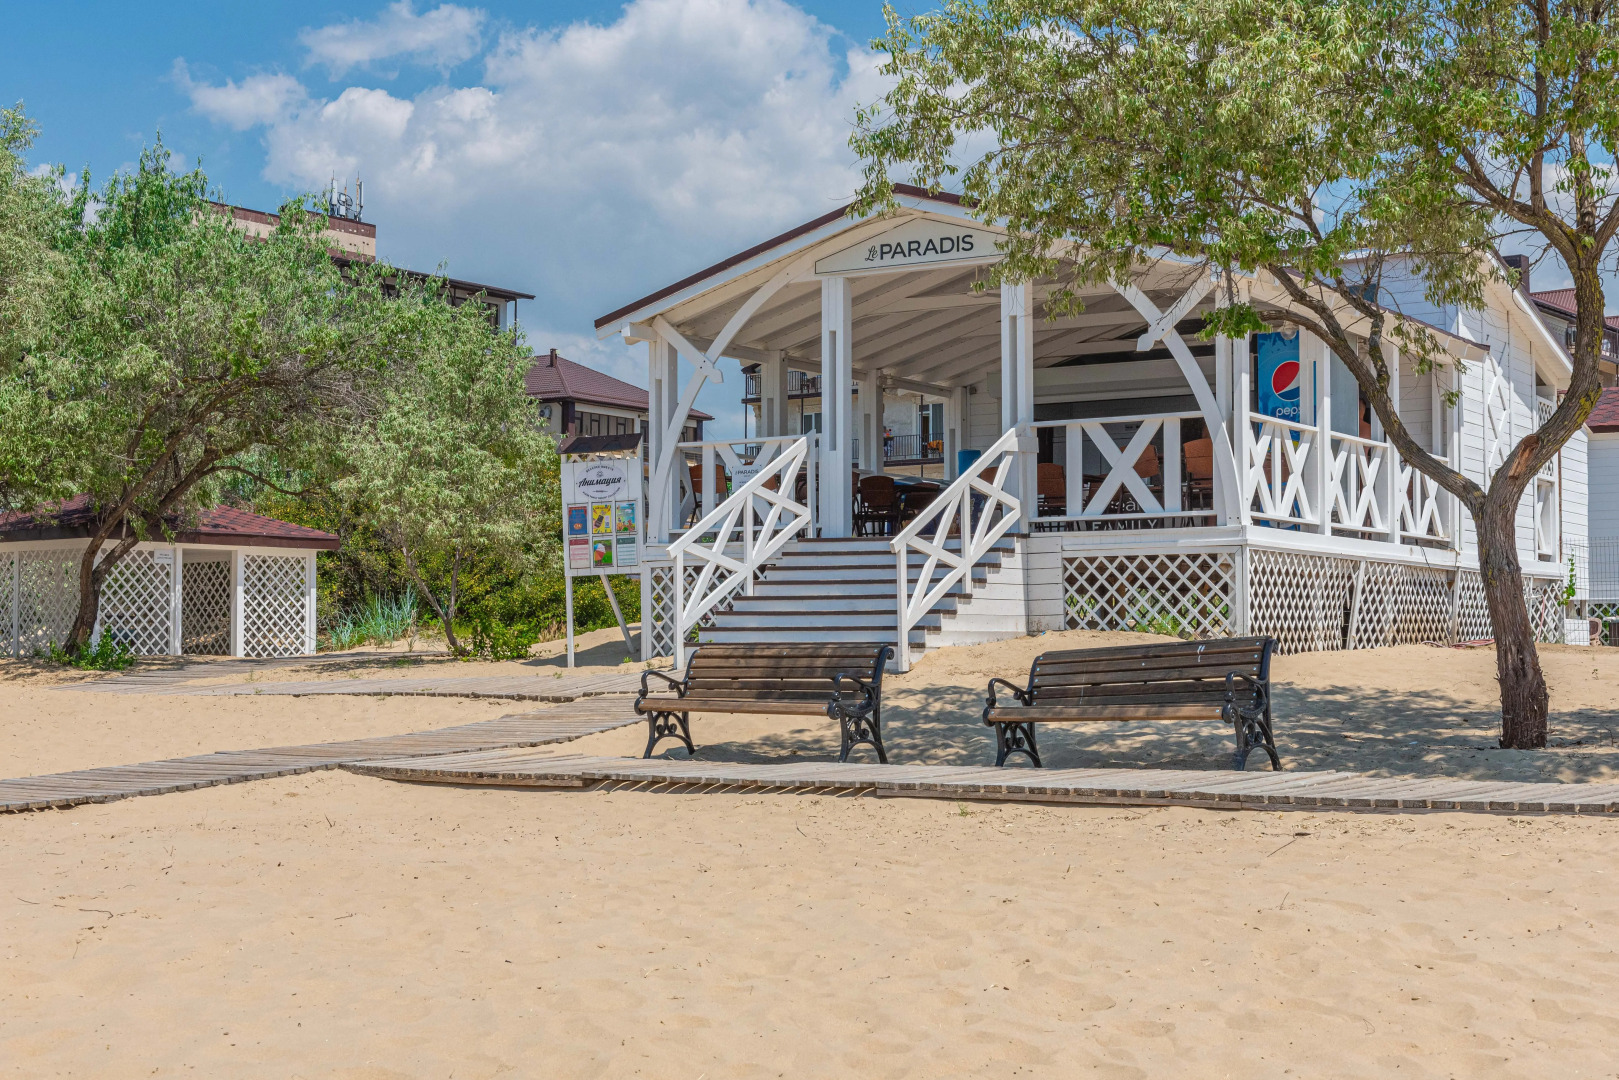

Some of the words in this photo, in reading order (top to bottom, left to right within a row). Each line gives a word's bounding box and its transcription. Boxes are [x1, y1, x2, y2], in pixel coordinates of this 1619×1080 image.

[865, 245, 878, 261] Le
[880, 234, 974, 260] PARADIS
[1276, 406, 1300, 418] pep
[578, 477, 622, 488] Анимация
